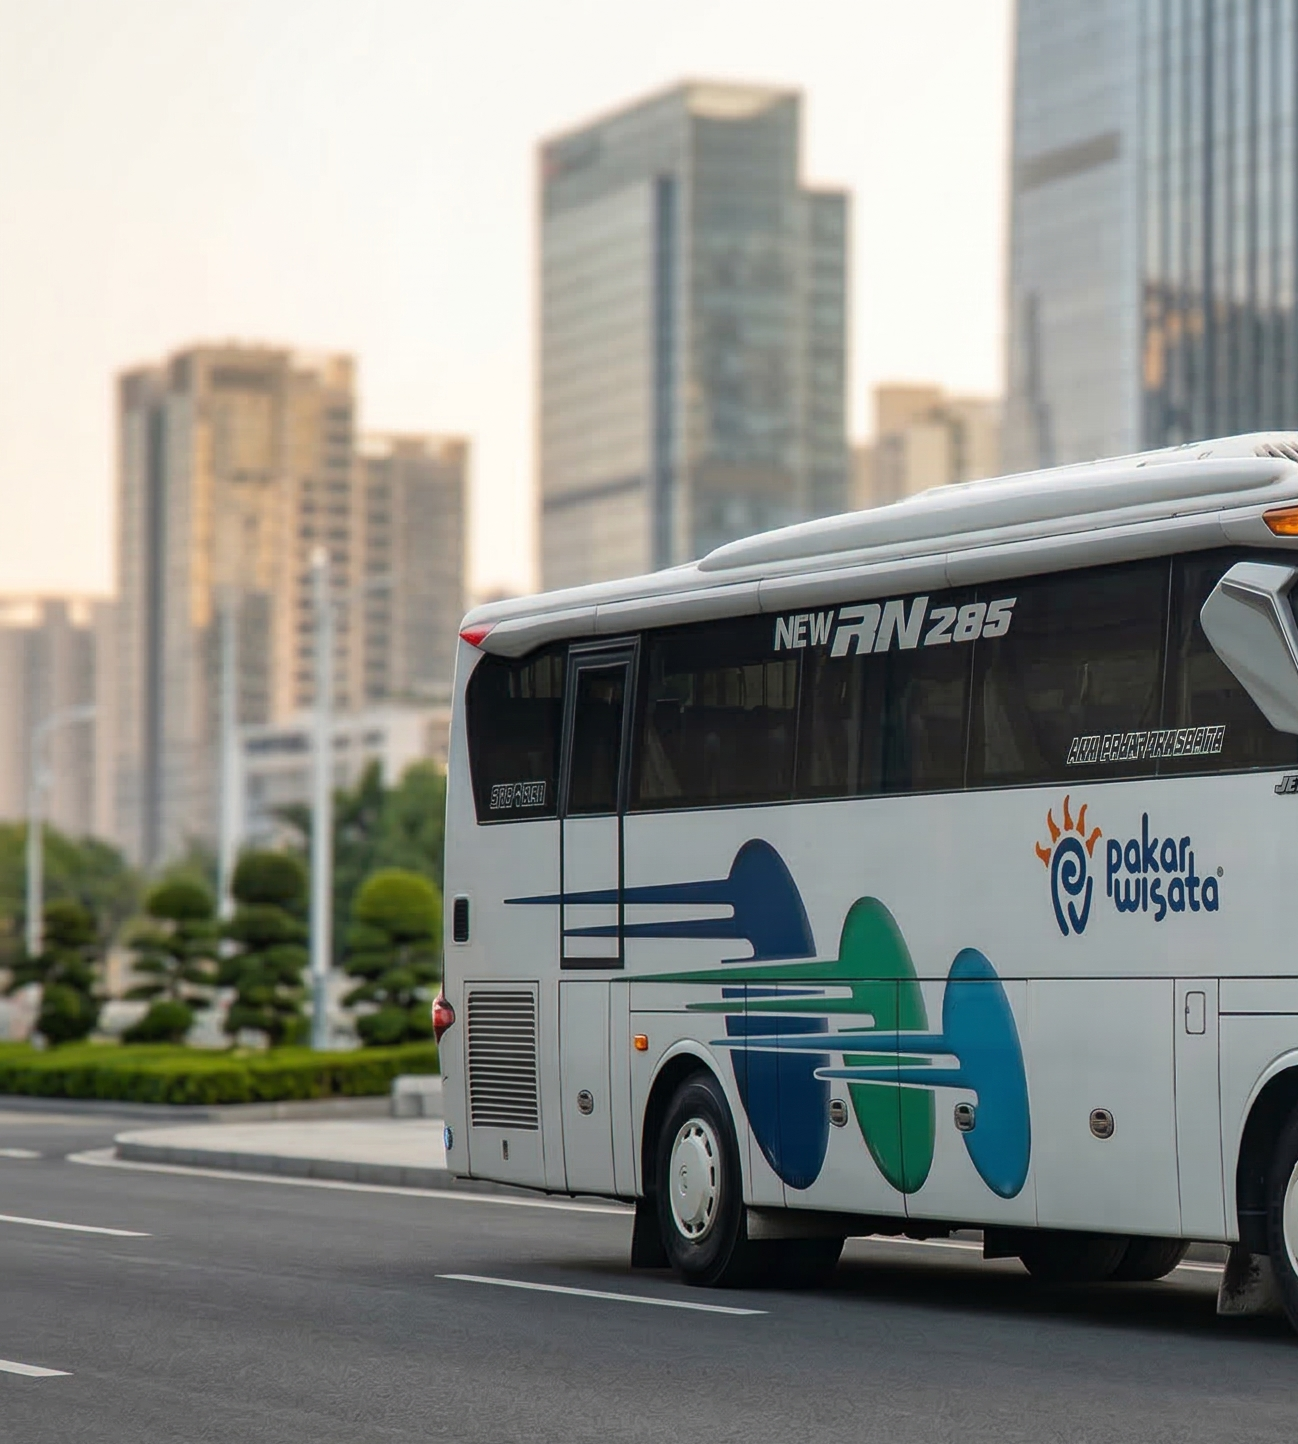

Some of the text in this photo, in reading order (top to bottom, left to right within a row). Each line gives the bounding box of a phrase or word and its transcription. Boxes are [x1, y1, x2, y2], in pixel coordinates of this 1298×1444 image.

[774, 610, 834, 651] NEW
[923, 597, 1017, 646] 285
[1106, 812, 1191, 898] pakar
[1113, 851, 1219, 922] wisata
